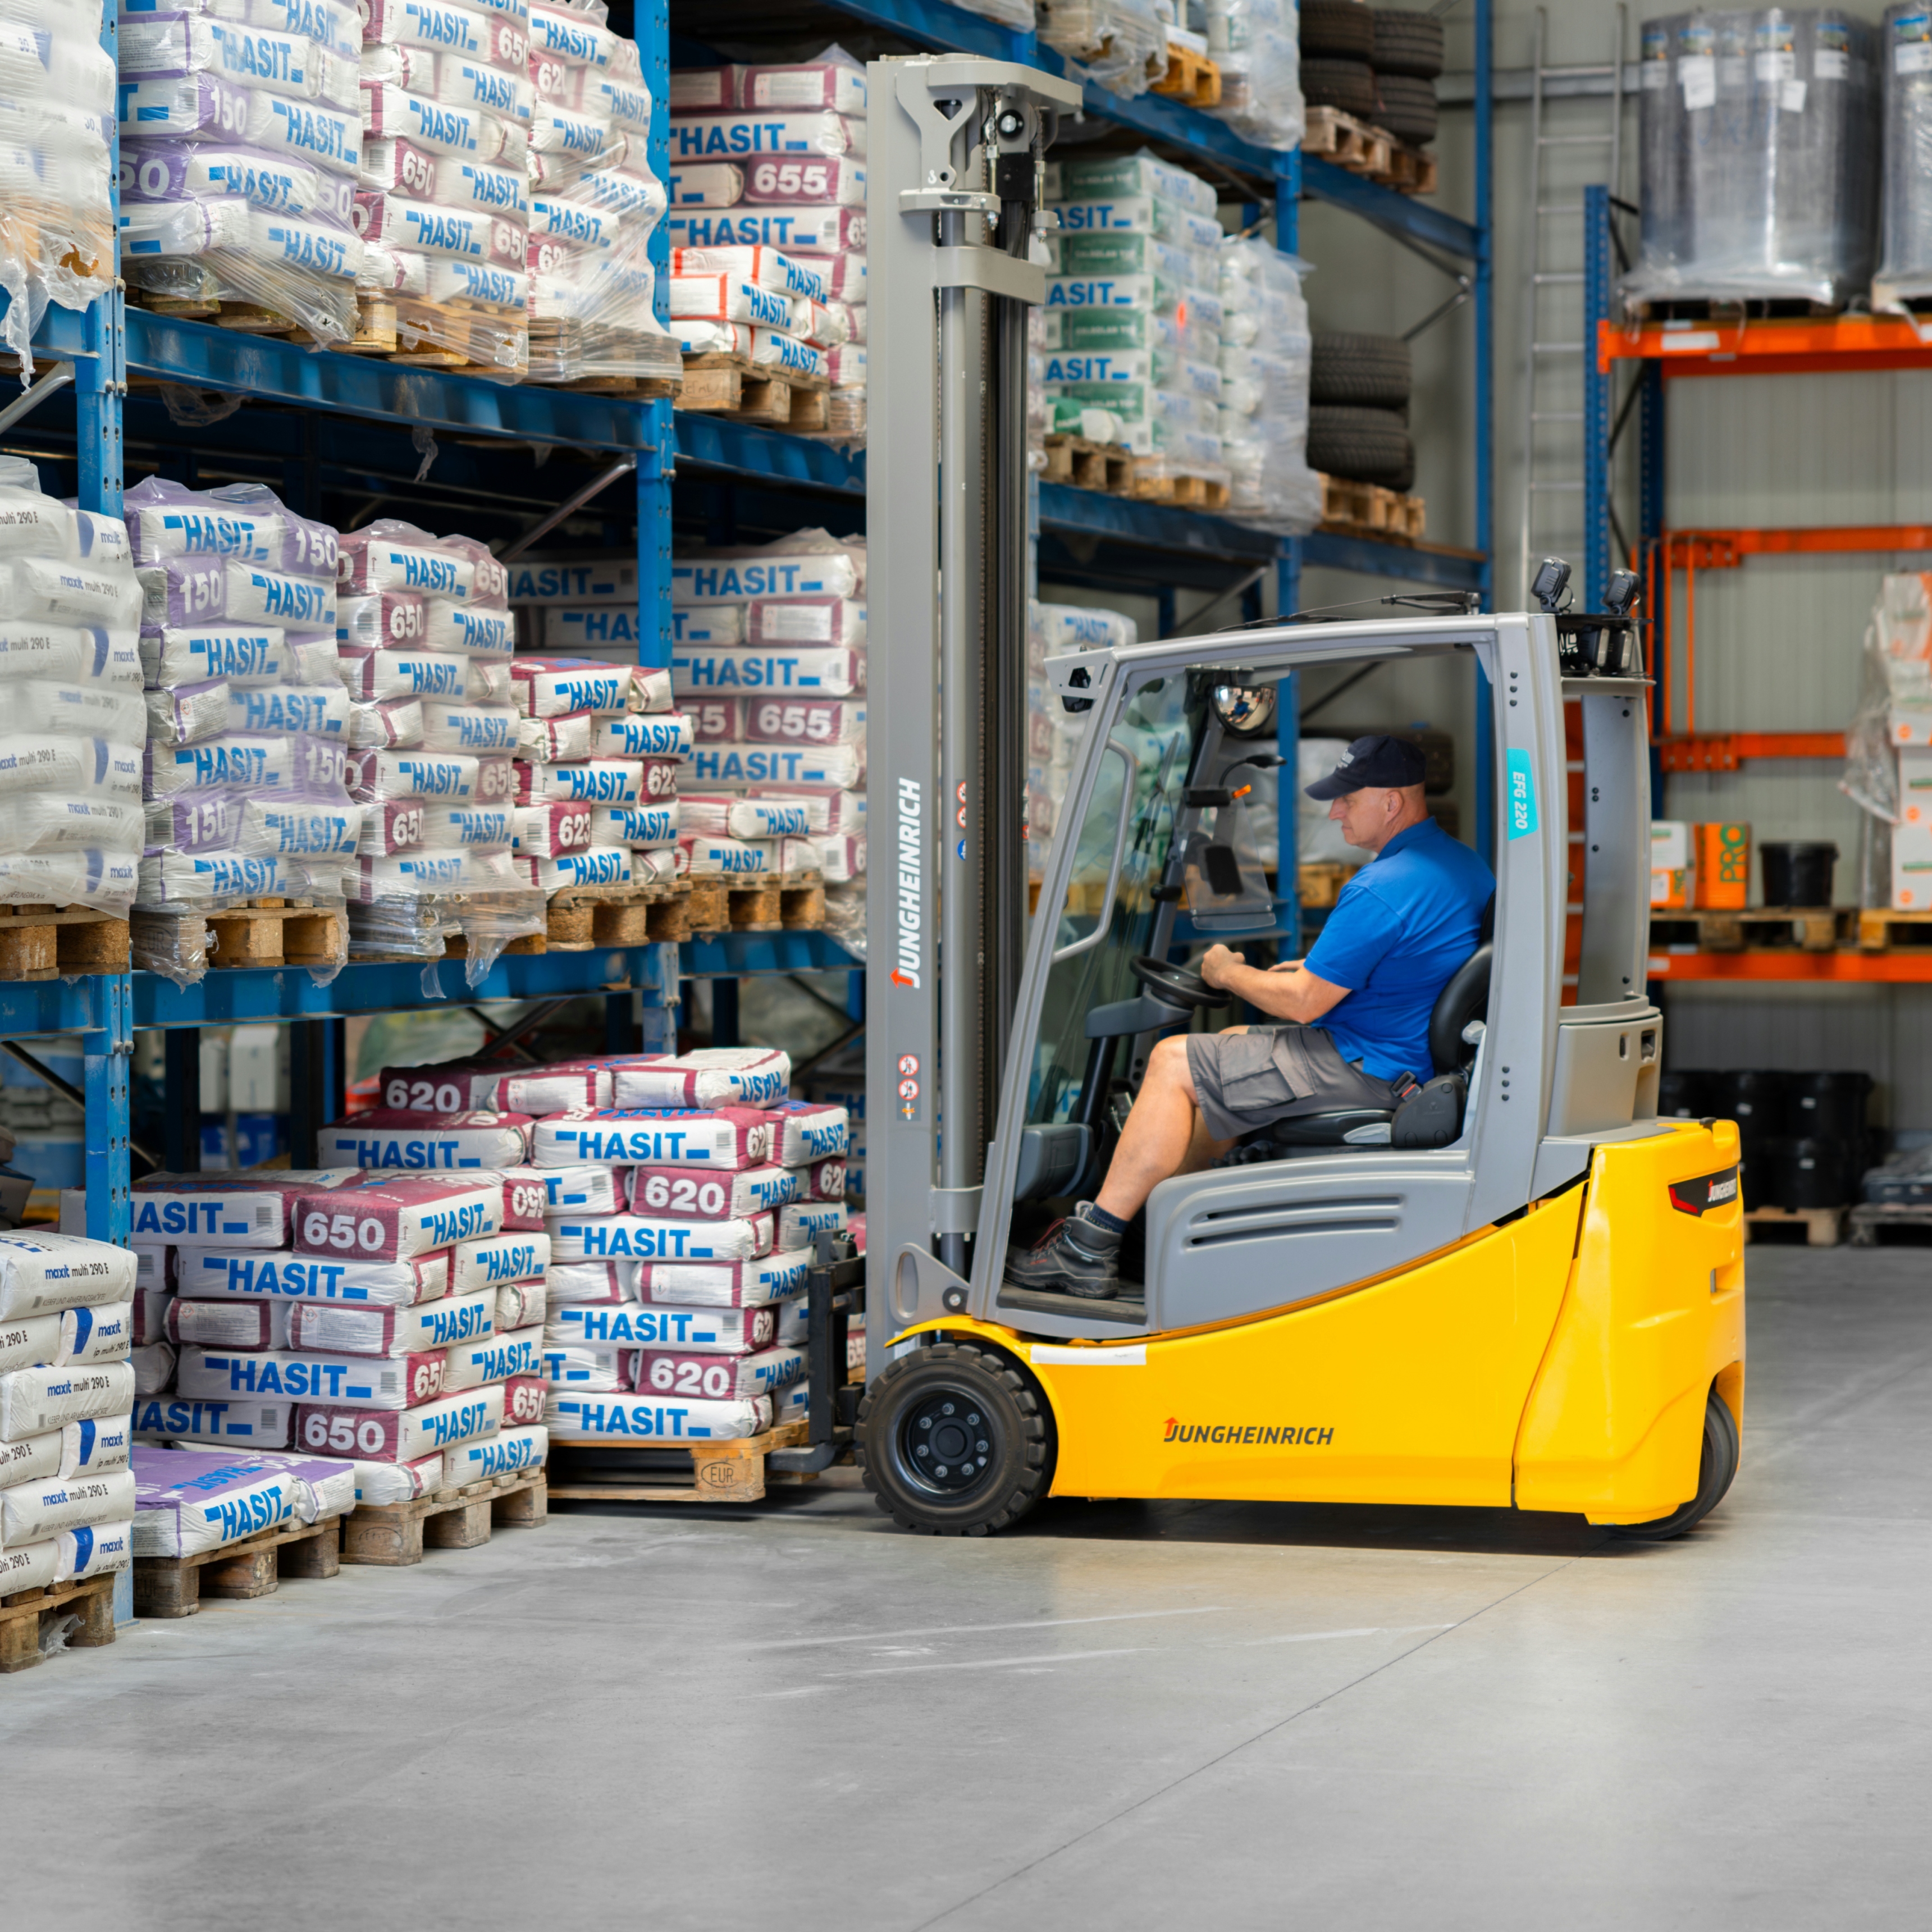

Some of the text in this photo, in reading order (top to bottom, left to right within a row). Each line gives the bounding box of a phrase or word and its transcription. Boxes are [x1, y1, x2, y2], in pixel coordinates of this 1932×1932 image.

[285, 0, 340, 49] HASIT
[417, 5, 469, 50] HASIT
[545, 21, 597, 61] HASIT
[222, 30, 291, 81] HASIT
[211, 85, 248, 135] 150
[611, 87, 645, 122] HASIT
[286, 104, 345, 161] HASIT
[421, 104, 470, 148] HASIT
[563, 121, 604, 156] HASIT
[680, 124, 785, 155] HASIT
[225, 166, 293, 211] HASIT
[403, 150, 435, 196] 650
[473, 170, 519, 209] HASIT
[754, 163, 827, 195] 655
[418, 212, 472, 252] HASIT
[548, 205, 602, 245] HASIT
[688, 217, 794, 246] HASIT
[284, 228, 346, 275] HASIT
[467, 266, 516, 305] HASIT
[786, 262, 821, 298] HASIT
[750, 291, 787, 325] HASIT
[781, 338, 819, 373] HASIT
[17, 511, 38, 524] 290 E
[182, 515, 255, 558] HASIT
[296, 528, 337, 569] 150
[60, 575, 84, 590] maxit
[85, 581, 101, 593] multi
[102, 583, 114, 596] 290
[404, 555, 457, 592] HASIT
[695, 565, 801, 596] HASIT
[179, 570, 221, 613] 150
[264, 577, 325, 622] HASIT
[11, 637, 29, 651] multi
[30, 637, 44, 650] 290
[46, 637, 50, 650] E
[463, 614, 506, 651] HASIT
[114, 648, 135, 663] maxit
[206, 638, 269, 677] HASIT
[692, 658, 798, 687] HASIT
[411, 663, 457, 695] HASIT
[569, 680, 618, 711] HASIT
[245, 693, 326, 732] HASIT
[759, 704, 832, 739] 655
[459, 716, 508, 747] HASIT
[624, 725, 681, 754] HASIT
[19, 749, 56, 766] multi 290 E
[115, 760, 135, 774] maxit
[194, 747, 267, 786] HASIT
[306, 743, 345, 786] 150
[696, 752, 803, 781] HASIT
[412, 762, 462, 794] HASIT
[570, 770, 627, 801] HASIT
[67, 802, 90, 815] maxit
[1513, 771, 1528, 829] EFG 220
[186, 800, 227, 844] 150
[278, 815, 346, 853] HASIT
[460, 814, 506, 843] HASIT
[623, 811, 670, 841] HASIT
[767, 809, 805, 835] HASIT
[111, 865, 133, 879] maxit
[212, 857, 278, 896] HASIT
[413, 858, 462, 886] HASIT
[572, 852, 622, 886] HASIT
[721, 849, 763, 871] HASIT
[898, 777, 921, 989] JUNGHEINRICH
[386, 1080, 460, 1113] 620
[739, 1071, 781, 1102] HASIT
[358, 1140, 458, 1168] HASIT
[579, 1131, 686, 1159] HASIT
[810, 1123, 844, 1157] HASIT
[646, 1176, 724, 1214] 620
[760, 1176, 797, 1210] HASIT
[304, 1212, 385, 1252] 650
[432, 1203, 485, 1245] HASIT
[807, 1213, 839, 1242] HASIT
[584, 1227, 690, 1257] HASIT
[45, 1263, 109, 1280] maxit multi 290 E
[228, 1258, 345, 1298] HASIT
[487, 1245, 535, 1281] HASIT
[769, 1264, 807, 1299] HASIT
[6, 1331, 21, 1347] 290
[22, 1330, 28, 1342] E
[98, 1319, 121, 1337] maxit
[432, 1304, 484, 1344] HASIT
[585, 1312, 692, 1342] HASIT
[94, 1348, 100, 1358] ip
[115, 1341, 125, 1353] 290
[125, 1340, 130, 1349] E
[482, 1342, 532, 1381] HASIT
[48, 1376, 109, 1397] maxit multi 290 E
[231, 1359, 347, 1398] HASIT
[414, 1360, 446, 1398] 650
[650, 1358, 729, 1398] 620
[765, 1356, 801, 1392] HASIT
[48, 1412, 70, 1424] KLEBER UND
[512, 1386, 546, 1422] 650
[582, 1404, 688, 1436] HASIT
[101, 1432, 123, 1448] maxit
[304, 1414, 385, 1453] 650
[434, 1402, 487, 1446] HASIT
[1163, 1424, 1334, 1445] JUNGHEINRICH
[11, 1444, 32, 1460] 290 E
[117, 1454, 126, 1465] 290
[481, 1438, 533, 1477] HASIT
[710, 1467, 733, 1483] EUR
[43, 1484, 108, 1506] maxit multi 290 E
[221, 1486, 282, 1541] HASIT
[10, 1553, 30, 1569] 290 E
[100, 1537, 123, 1554] maxit
[116, 1559, 127, 1570] 290
